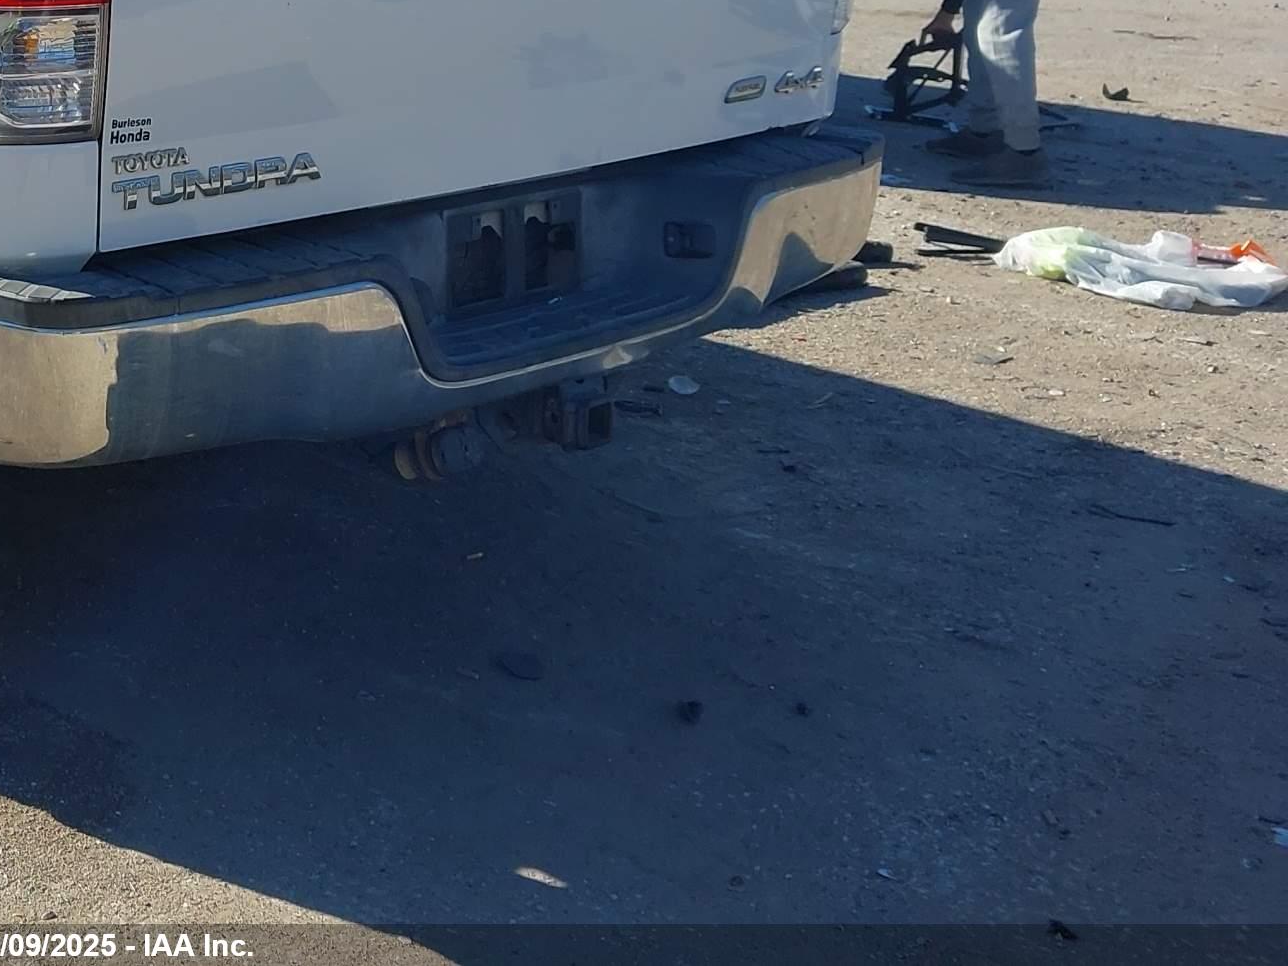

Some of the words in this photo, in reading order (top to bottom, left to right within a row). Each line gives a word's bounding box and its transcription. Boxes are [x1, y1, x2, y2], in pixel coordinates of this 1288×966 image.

[112, 117, 152, 129] Burleson
[110, 128, 151, 144] Honda
[112, 147, 190, 174] TOYOTA
[111, 152, 322, 210] TUNDRA
